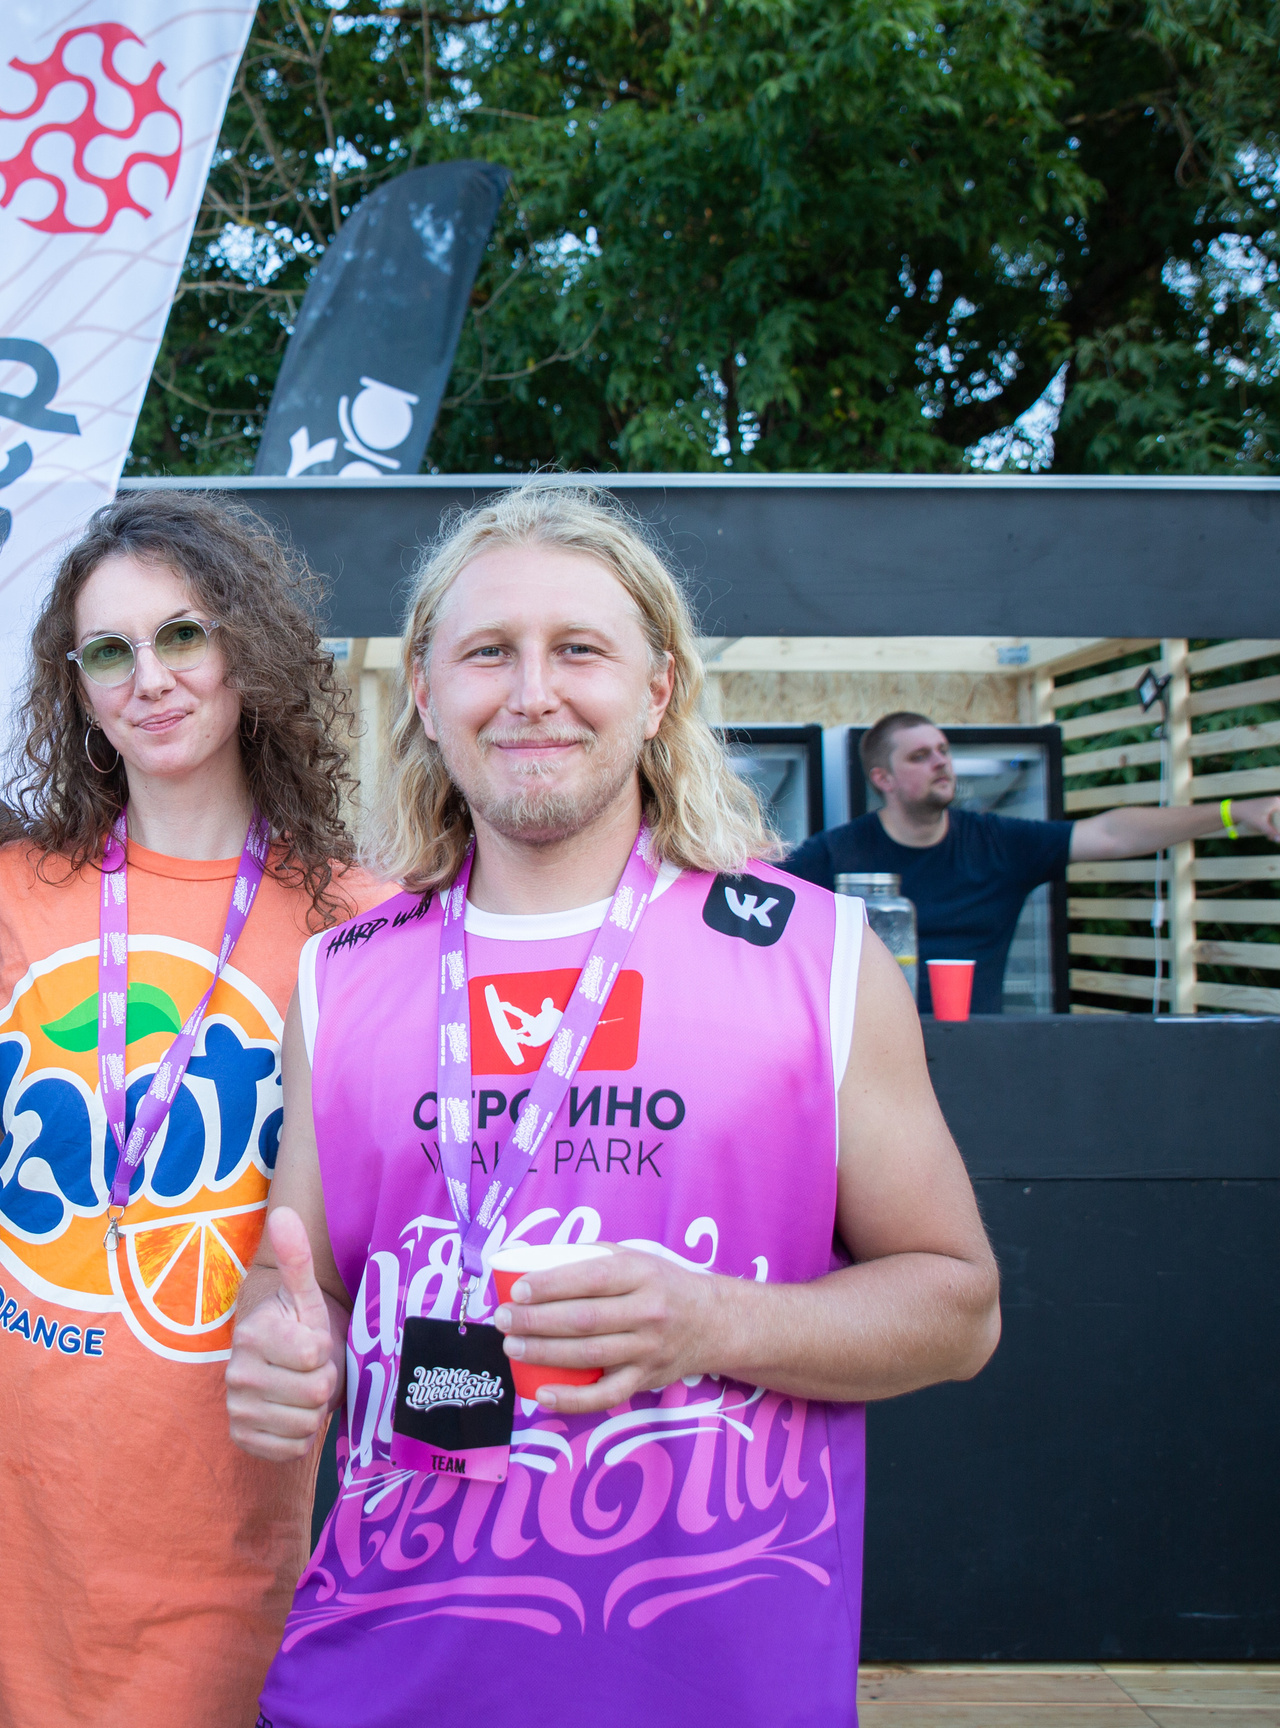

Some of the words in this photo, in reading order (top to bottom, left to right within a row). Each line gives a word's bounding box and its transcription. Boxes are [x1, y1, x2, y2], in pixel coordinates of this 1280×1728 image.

[724, 886, 780, 928] VK
[325, 917, 389, 962] HARD
[555, 1137, 664, 1178] PARK
[413, 1365, 471, 1388] Wake
[431, 1454, 466, 1474] TEAM
